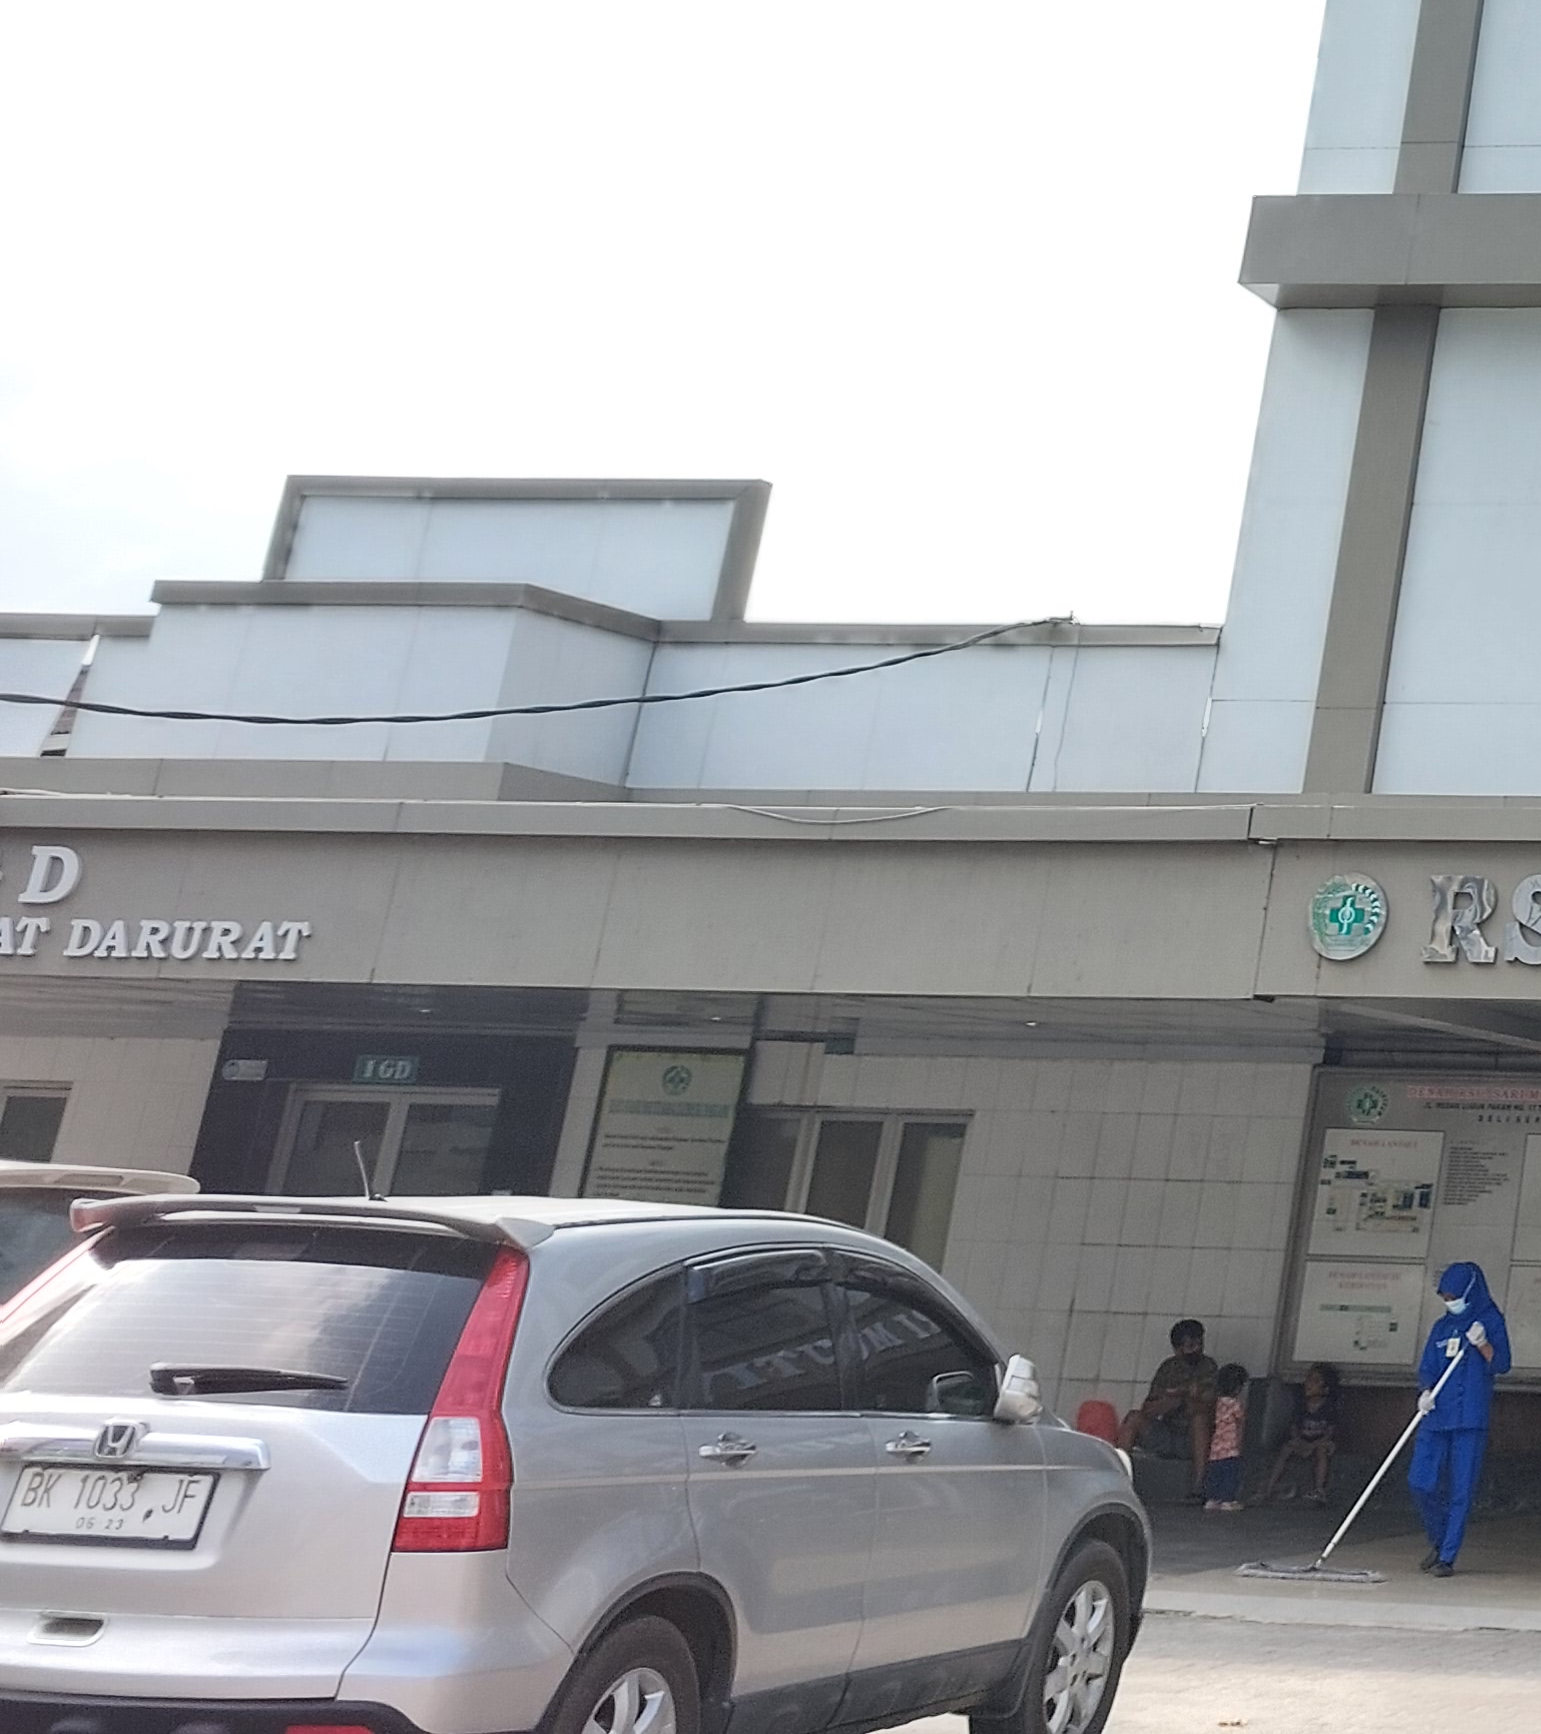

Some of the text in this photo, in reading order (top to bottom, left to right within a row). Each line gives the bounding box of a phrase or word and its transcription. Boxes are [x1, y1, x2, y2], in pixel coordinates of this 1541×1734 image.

[63, 918, 313, 960] DARURAT
[21, 1472, 200, 1514] BK 1033 JF
[76, 1516, 125, 1531] 06 23
